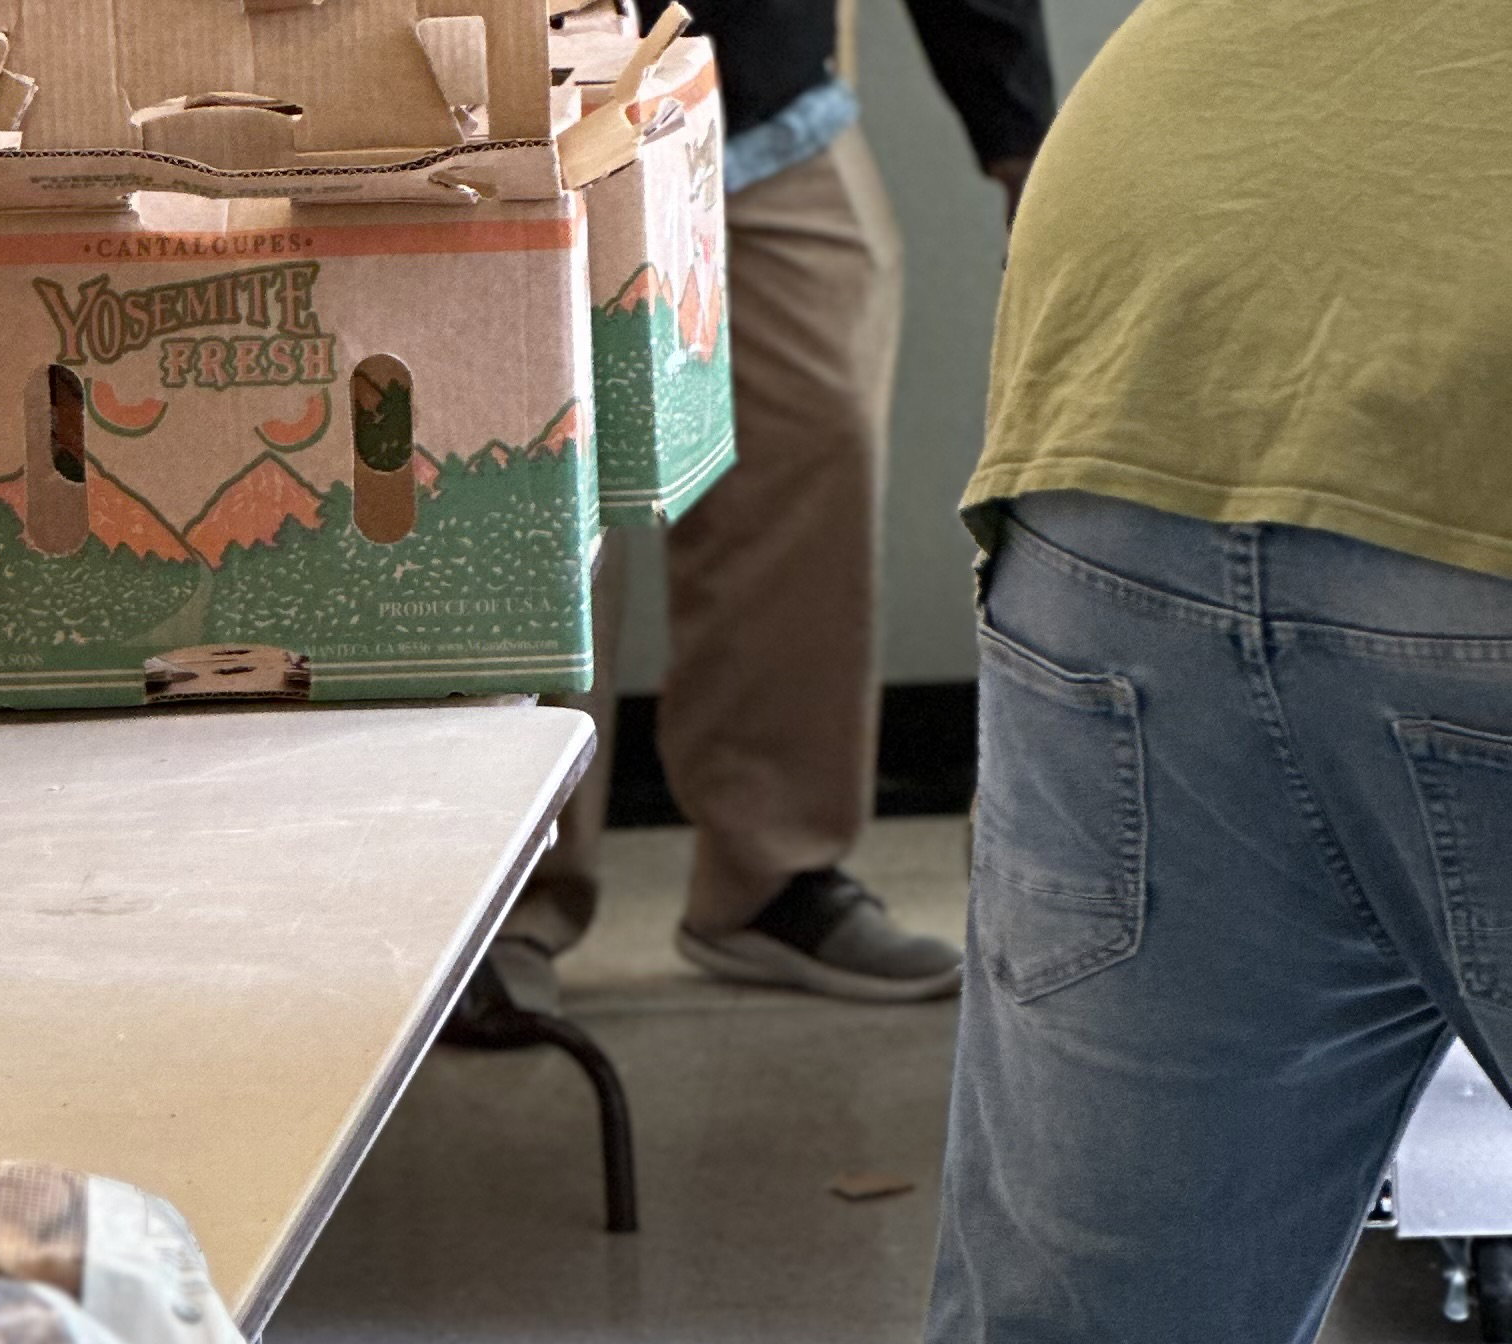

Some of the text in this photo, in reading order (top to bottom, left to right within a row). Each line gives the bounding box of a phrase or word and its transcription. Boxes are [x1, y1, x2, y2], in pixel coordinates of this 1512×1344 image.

[96, 233, 302, 257] CANTALOUPES
[31, 259, 321, 366] YOSEMITE
[159, 332, 338, 391] FRESH
[378, 598, 473, 619] PRODUCE
[476, 597, 500, 615] OF
